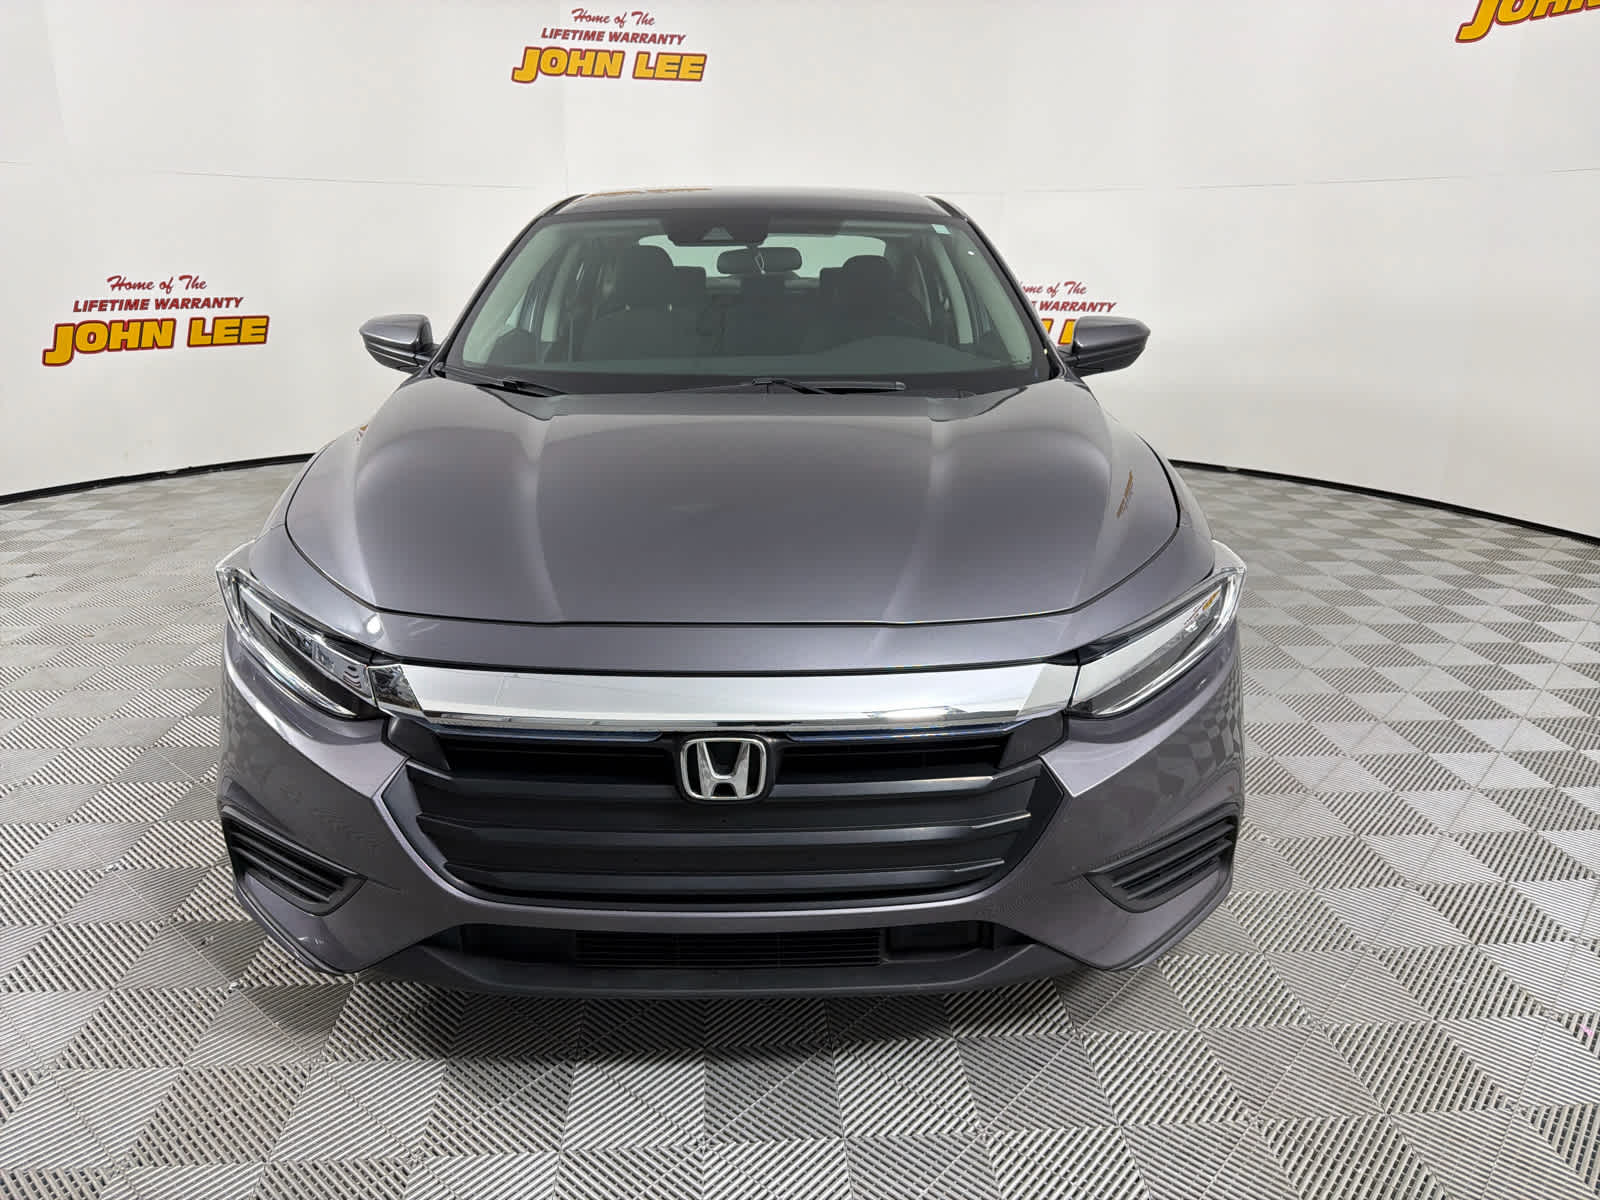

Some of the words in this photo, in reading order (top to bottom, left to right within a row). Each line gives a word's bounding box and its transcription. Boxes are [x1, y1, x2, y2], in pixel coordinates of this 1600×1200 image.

[571, 8, 610, 24] Home
[614, 12, 627, 28] of
[631, 11, 655, 26] The
[541, 28, 605, 42] LIFETIME
[608, 31, 687, 46] WARRANTY
[511, 46, 625, 84] JOHN
[632, 51, 707, 82] LEE
[106, 275, 155, 292] Home
[159, 277, 174, 294] of
[178, 275, 207, 290] The
[1020, 281, 1043, 294] ome
[1046, 282, 1060, 298] of
[1064, 281, 1087, 295] The
[73, 298, 151, 313] LIFETIME
[154, 297, 244, 310] WARRANTY
[1039, 300, 1117, 313] WARRANTY
[42, 318, 176, 367] JOHN
[186, 315, 270, 348] LEE
